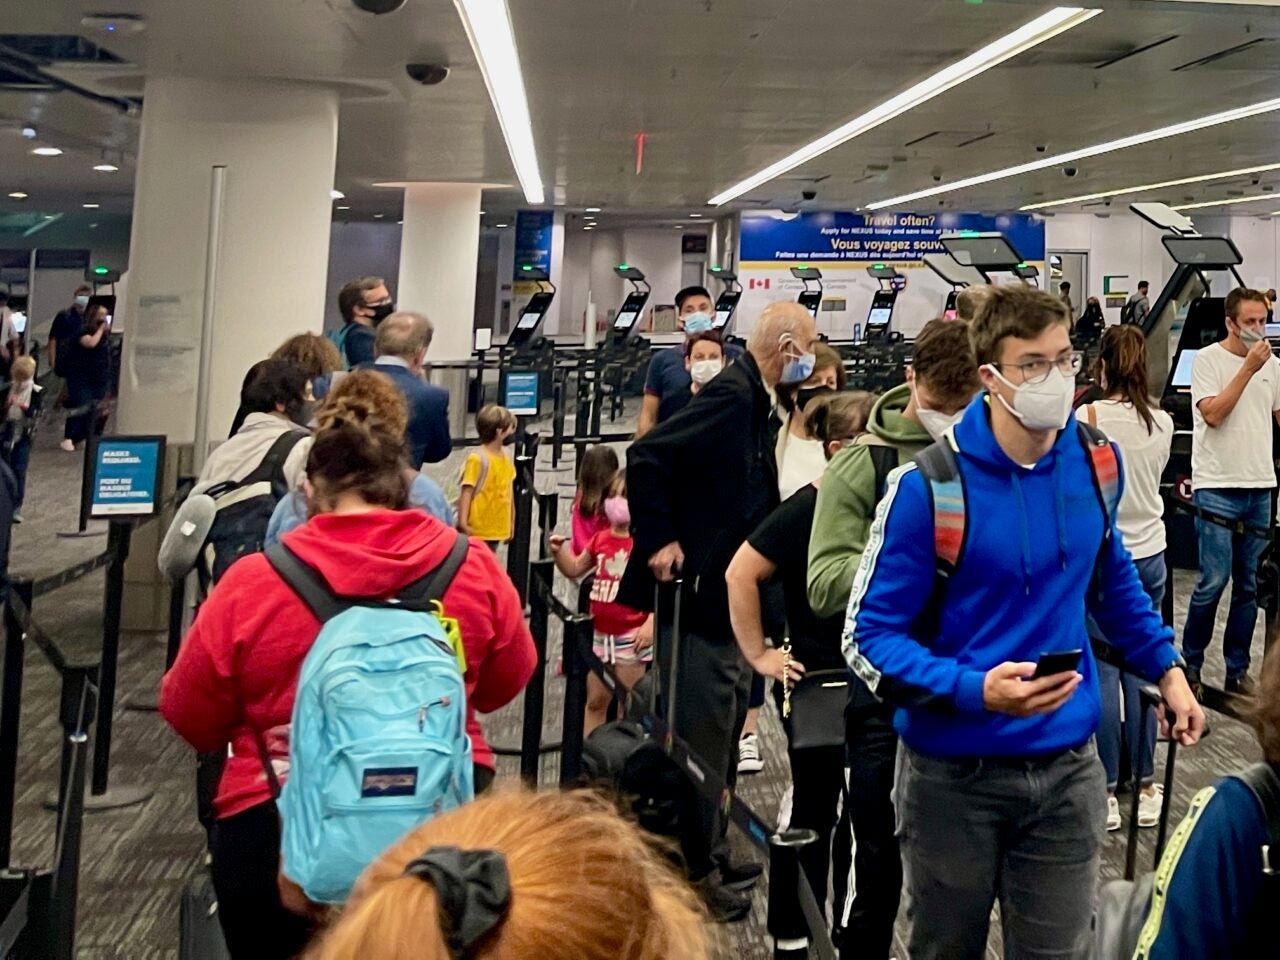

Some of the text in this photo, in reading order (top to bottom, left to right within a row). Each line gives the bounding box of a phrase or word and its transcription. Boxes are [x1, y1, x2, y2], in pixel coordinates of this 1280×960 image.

[864, 214, 936, 226] Travel often?
[820, 227, 840, 236] Apply
[831, 238, 944, 252] Vous voyagez souv
